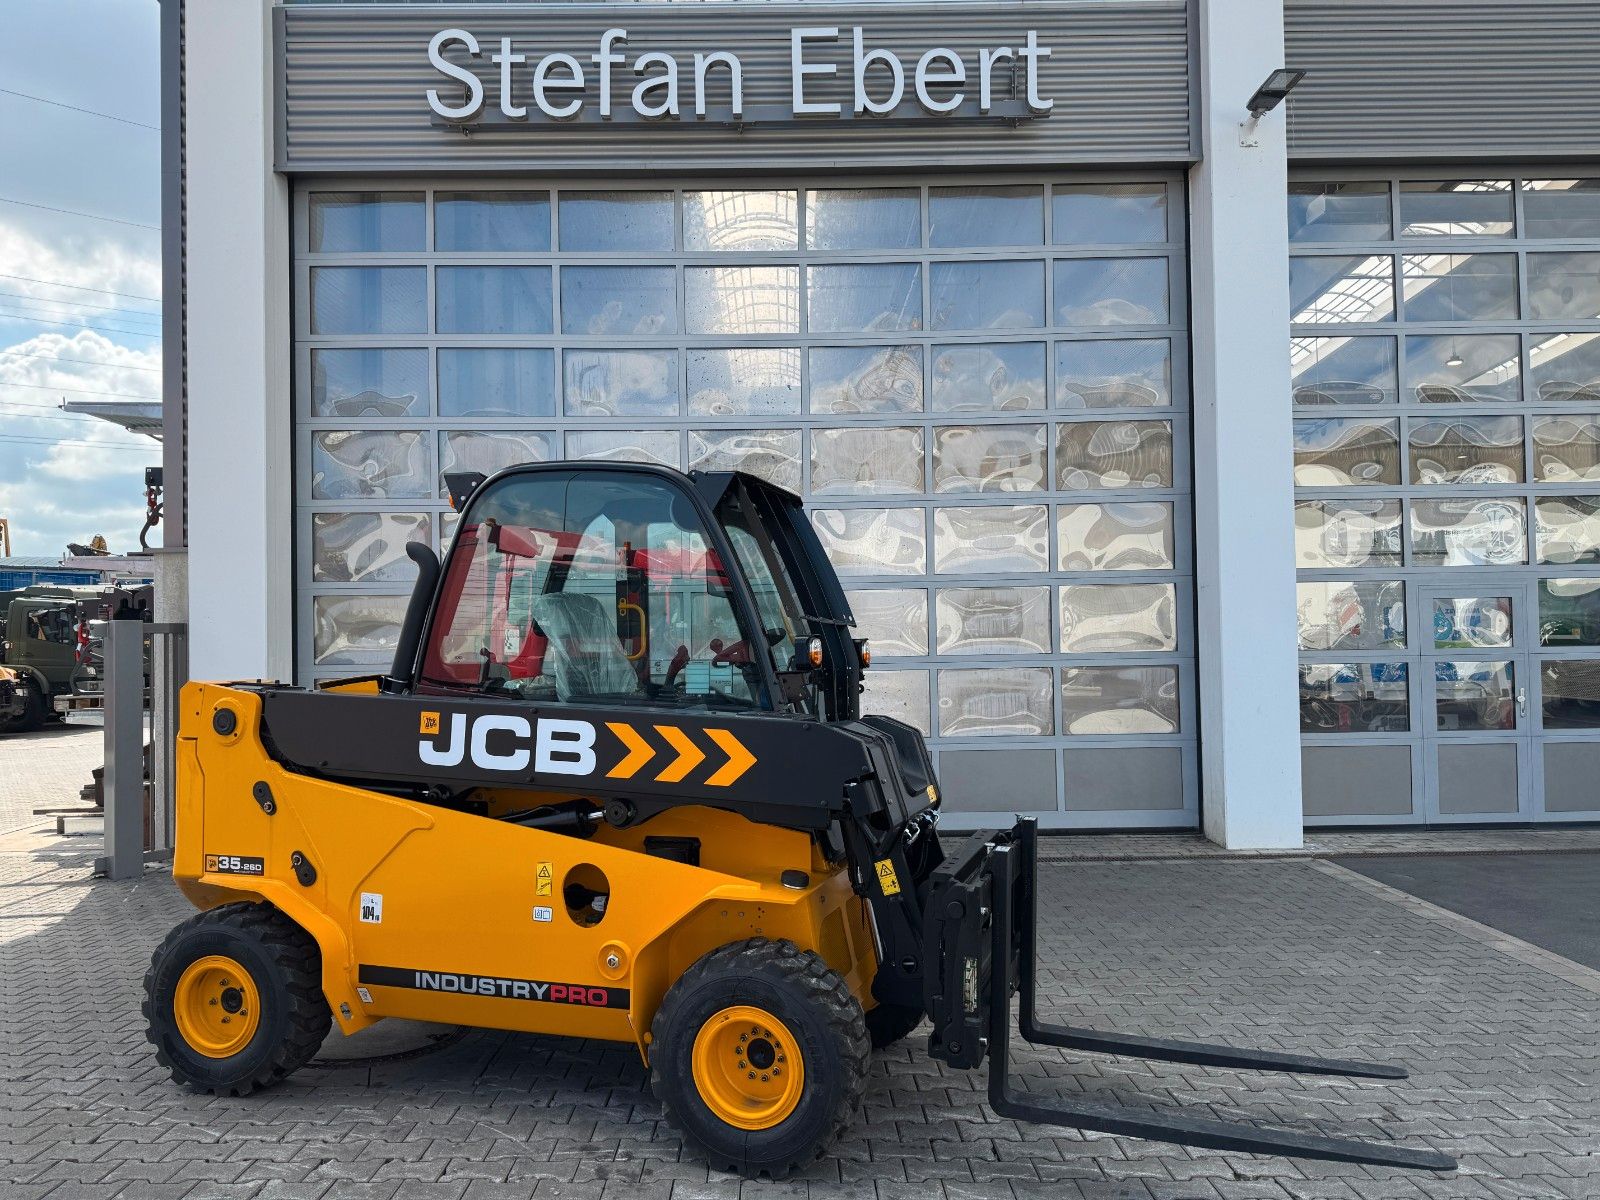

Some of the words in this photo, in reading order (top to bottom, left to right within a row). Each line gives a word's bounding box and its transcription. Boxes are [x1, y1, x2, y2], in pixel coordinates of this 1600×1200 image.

[425, 28, 744, 119] Stefan
[790, 27, 1054, 116] Ebert
[418, 713, 597, 776] JCB
